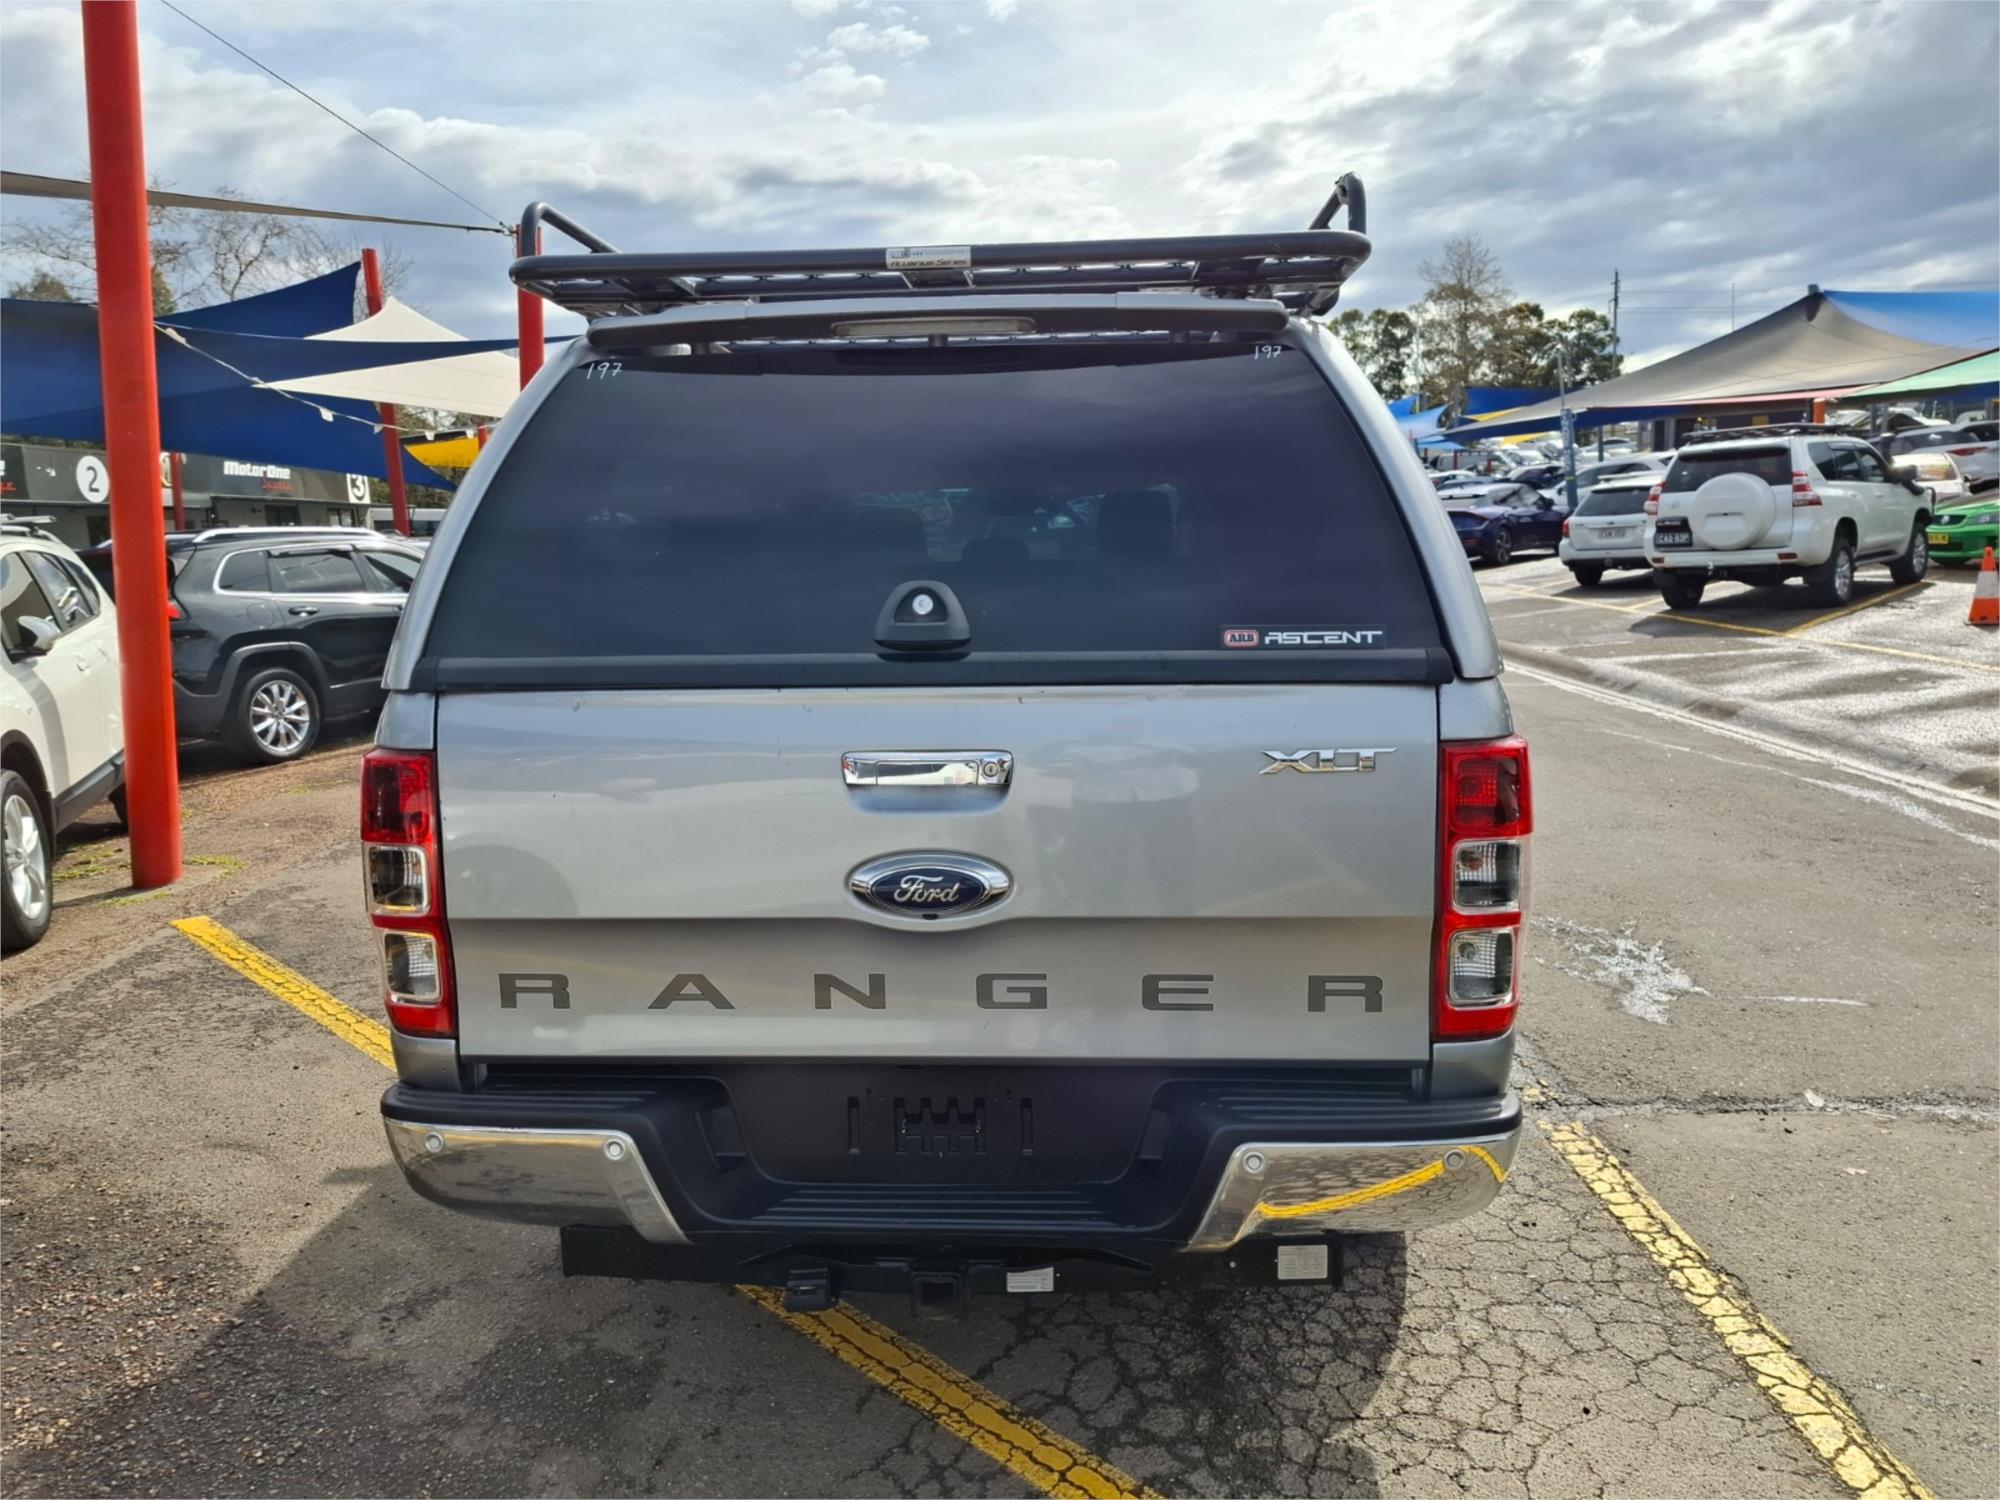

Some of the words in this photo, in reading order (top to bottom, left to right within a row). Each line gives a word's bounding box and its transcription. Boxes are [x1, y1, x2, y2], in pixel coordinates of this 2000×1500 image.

[1254, 345, 1282, 360] 197
[586, 362, 622, 380] 197
[86, 466, 100, 493] 2
[352, 475, 366, 499] 3
[1228, 632, 1256, 644] ARB
[1264, 631, 1383, 645] ASCENT
[1259, 747, 1399, 775] XLT
[894, 874, 961, 903] Ford
[498, 973, 1384, 1013] RANGER
